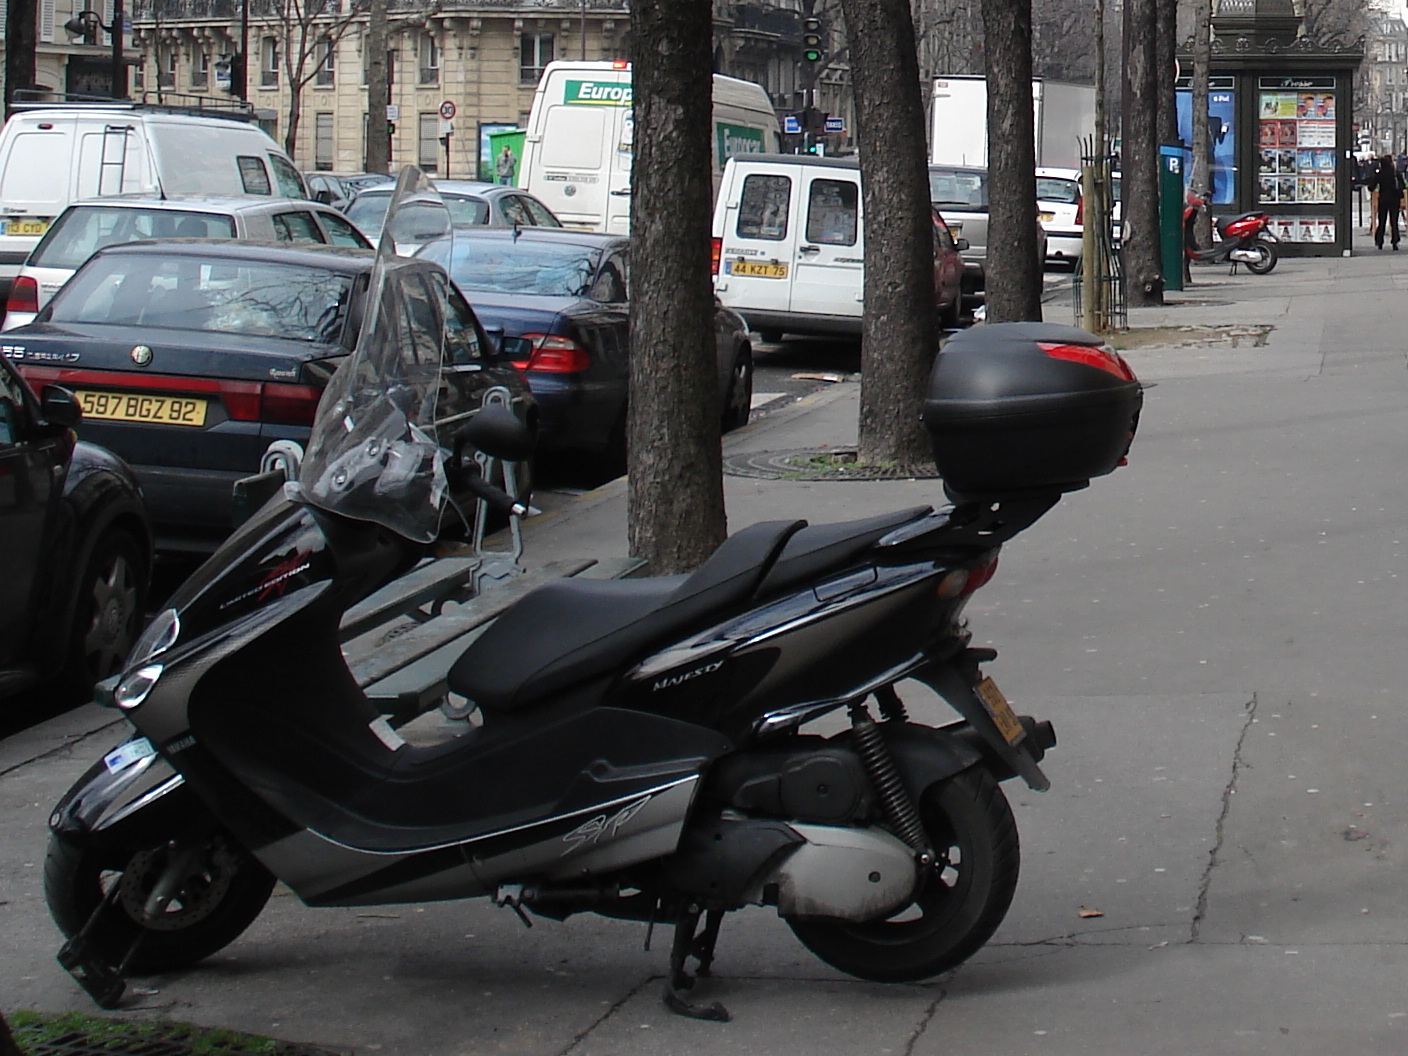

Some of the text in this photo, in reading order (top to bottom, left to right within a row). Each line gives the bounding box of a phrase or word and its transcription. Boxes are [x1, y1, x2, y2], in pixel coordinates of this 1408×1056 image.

[443, 106, 453, 115] 30
[1169, 156, 1179, 172] P
[733, 264, 785, 277] 44 KZT 75
[81, 394, 197, 422] 597 BGZ 92
[653, 659, 725, 692] MAJESTY
